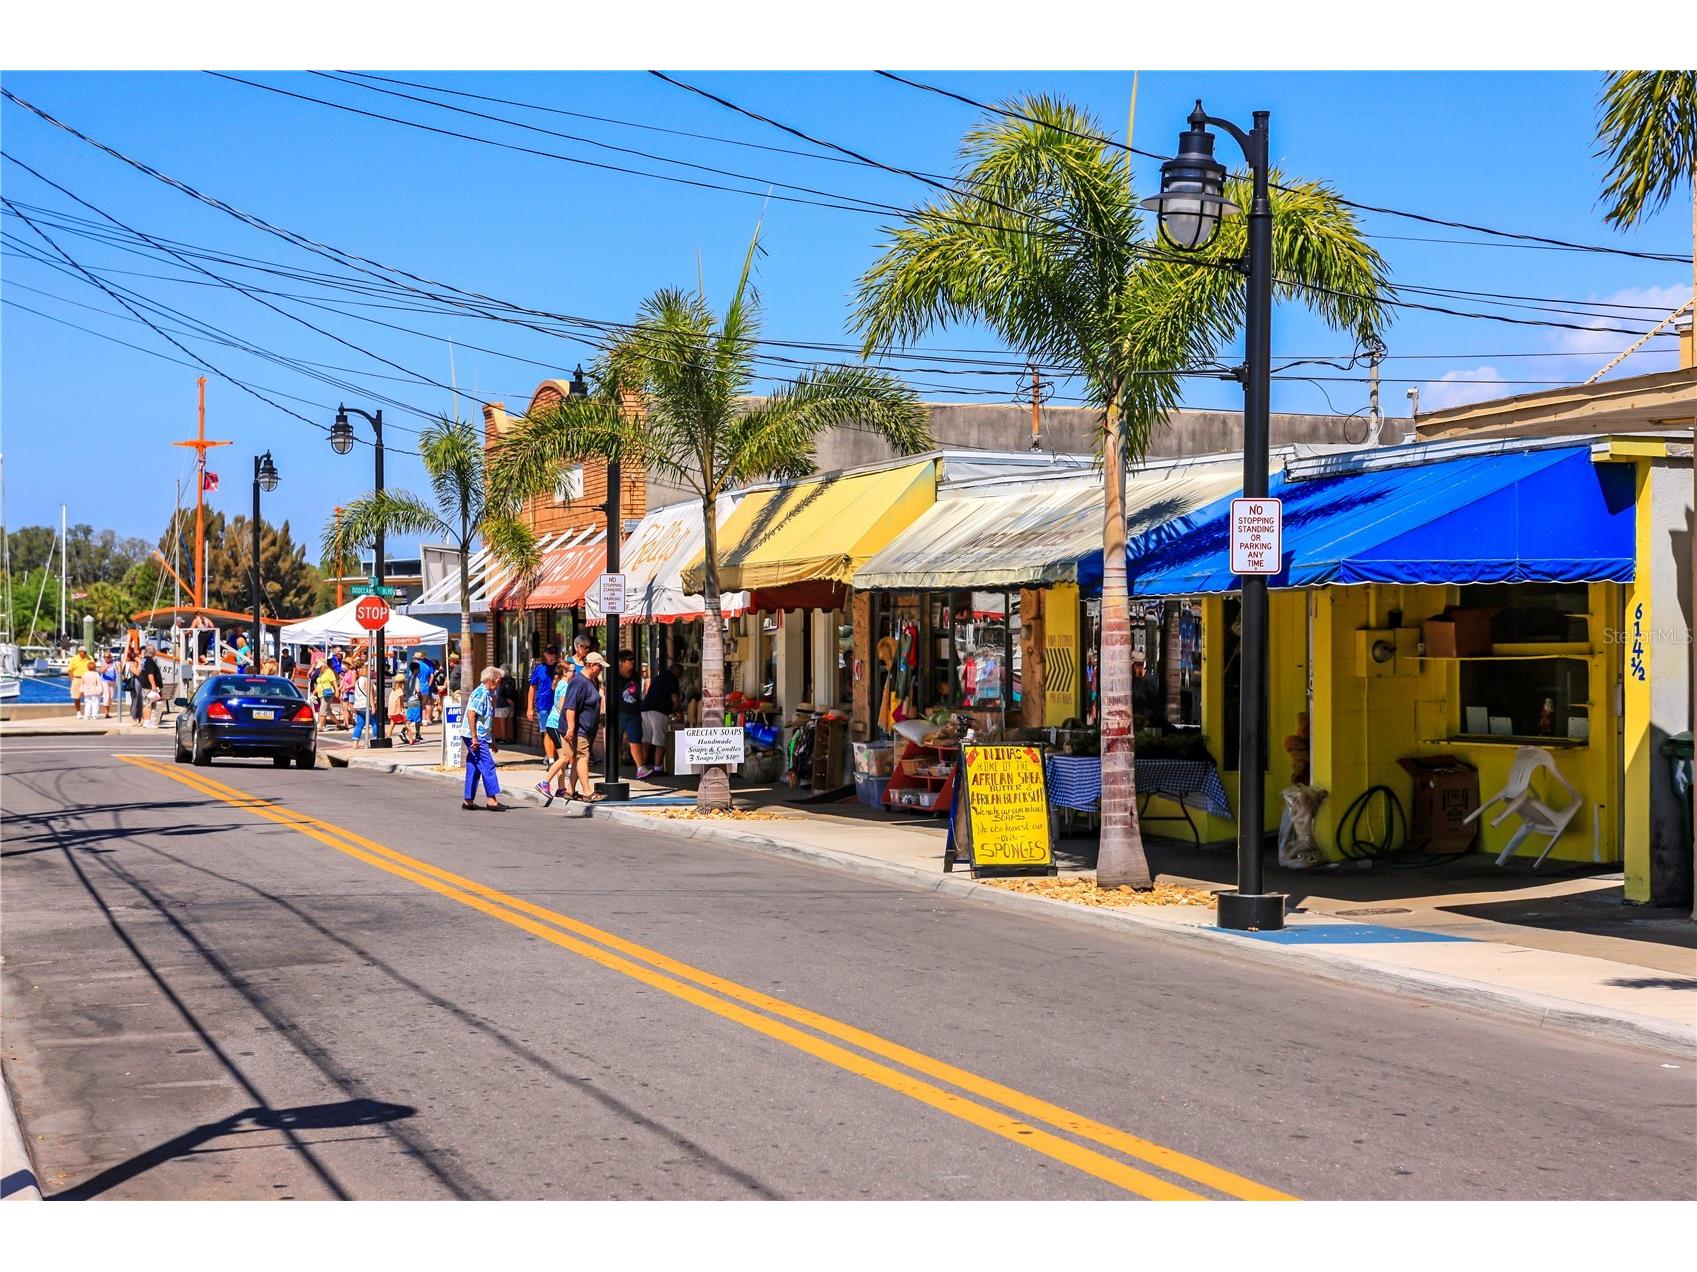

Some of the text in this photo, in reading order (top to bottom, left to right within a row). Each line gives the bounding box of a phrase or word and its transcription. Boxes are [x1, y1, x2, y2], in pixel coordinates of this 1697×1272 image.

[1249, 505, 1263, 515] NO
[1238, 517, 1274, 525] STOPPING
[1238, 525, 1274, 533] STANDING
[357, 606, 388, 620] STOP
[686, 728, 743, 737] GRECIAN SOAPS
[688, 746, 707, 754] Soaps
[716, 745, 741, 753] Candles
[689, 754, 694, 762] 3
[977, 761, 1029, 771] HOME OF THE
[972, 772, 1042, 785] AFRICAN SHEA
[970, 792, 1001, 805] AFRICAN
[979, 841, 1046, 861] SPONGES
